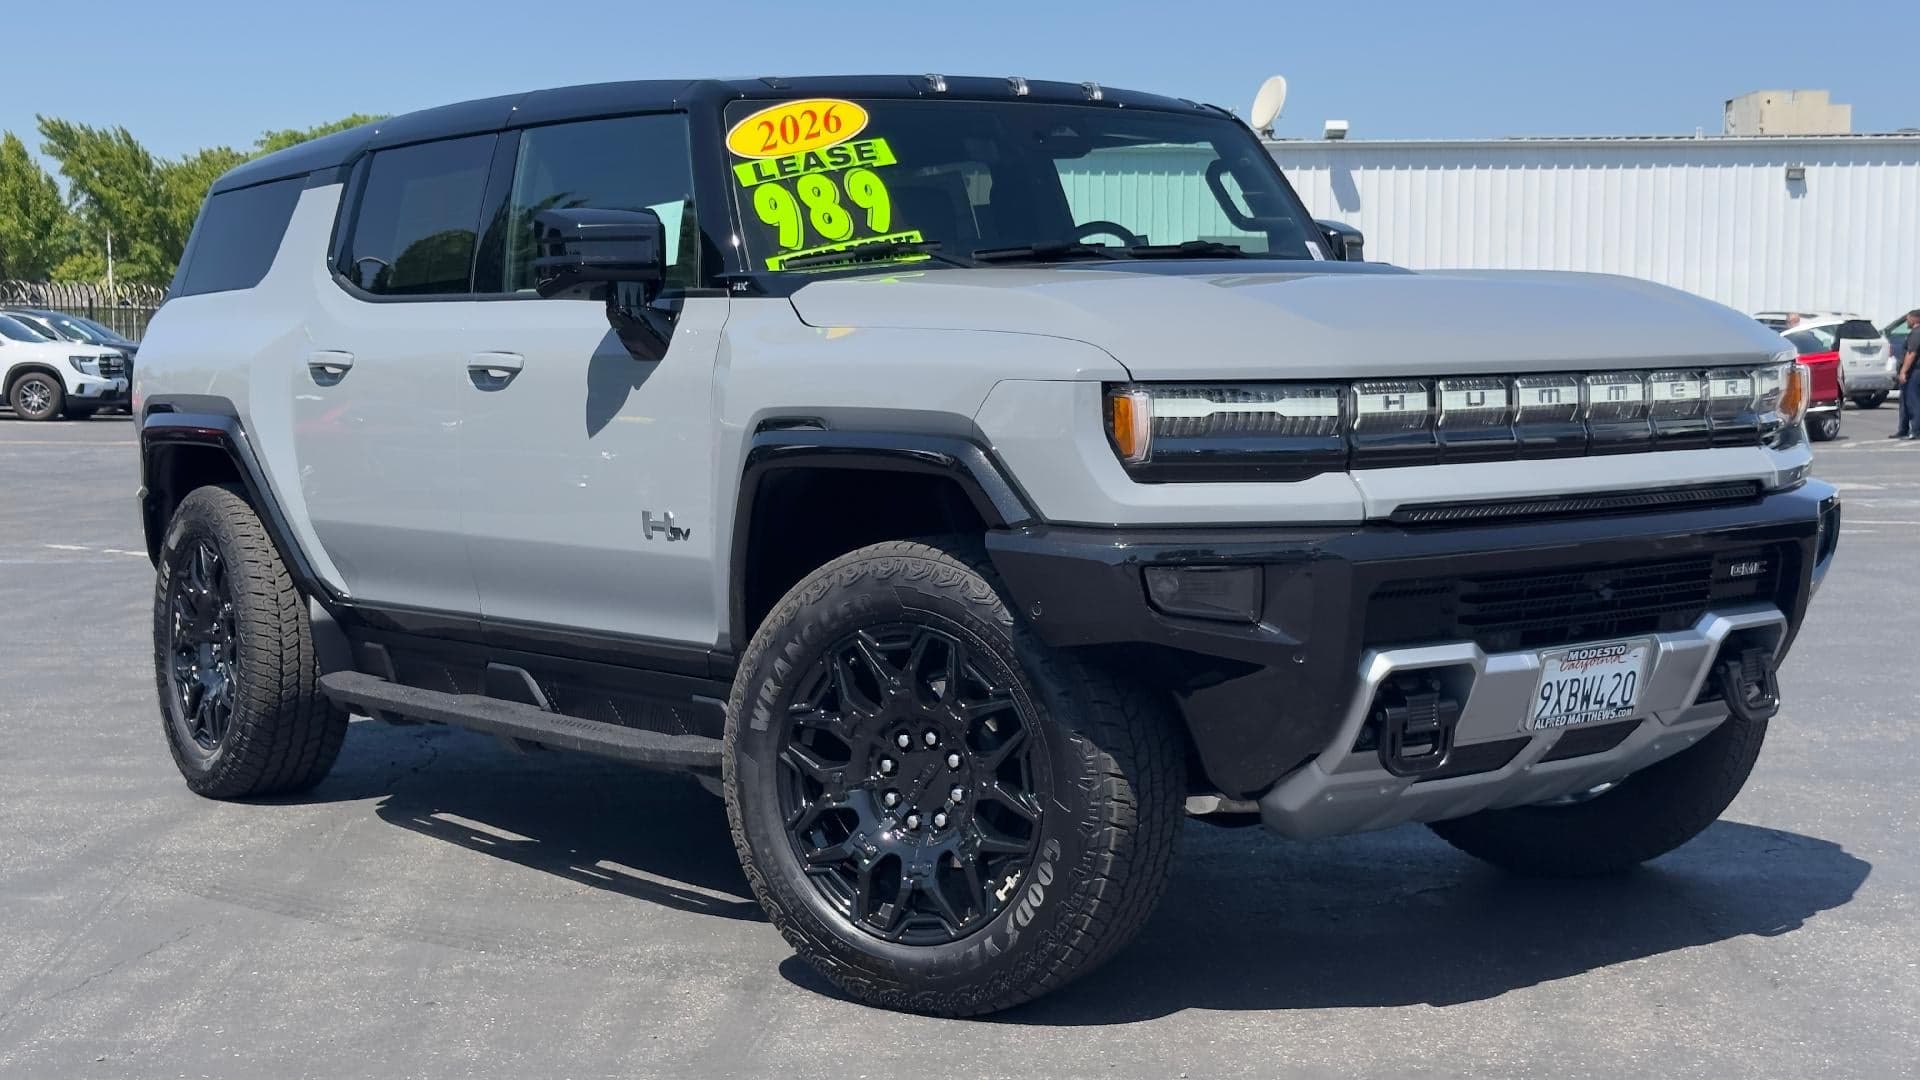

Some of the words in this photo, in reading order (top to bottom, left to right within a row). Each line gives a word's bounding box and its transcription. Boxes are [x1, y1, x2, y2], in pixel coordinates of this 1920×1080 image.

[757, 105, 842, 153] 2026
[752, 142, 878, 182] LEASE
[753, 167, 892, 250] 989
[1382, 380, 1738, 411] HUMMER
[1568, 646, 1626, 661] MODESTO
[1537, 670, 1637, 717] 9XBW420
